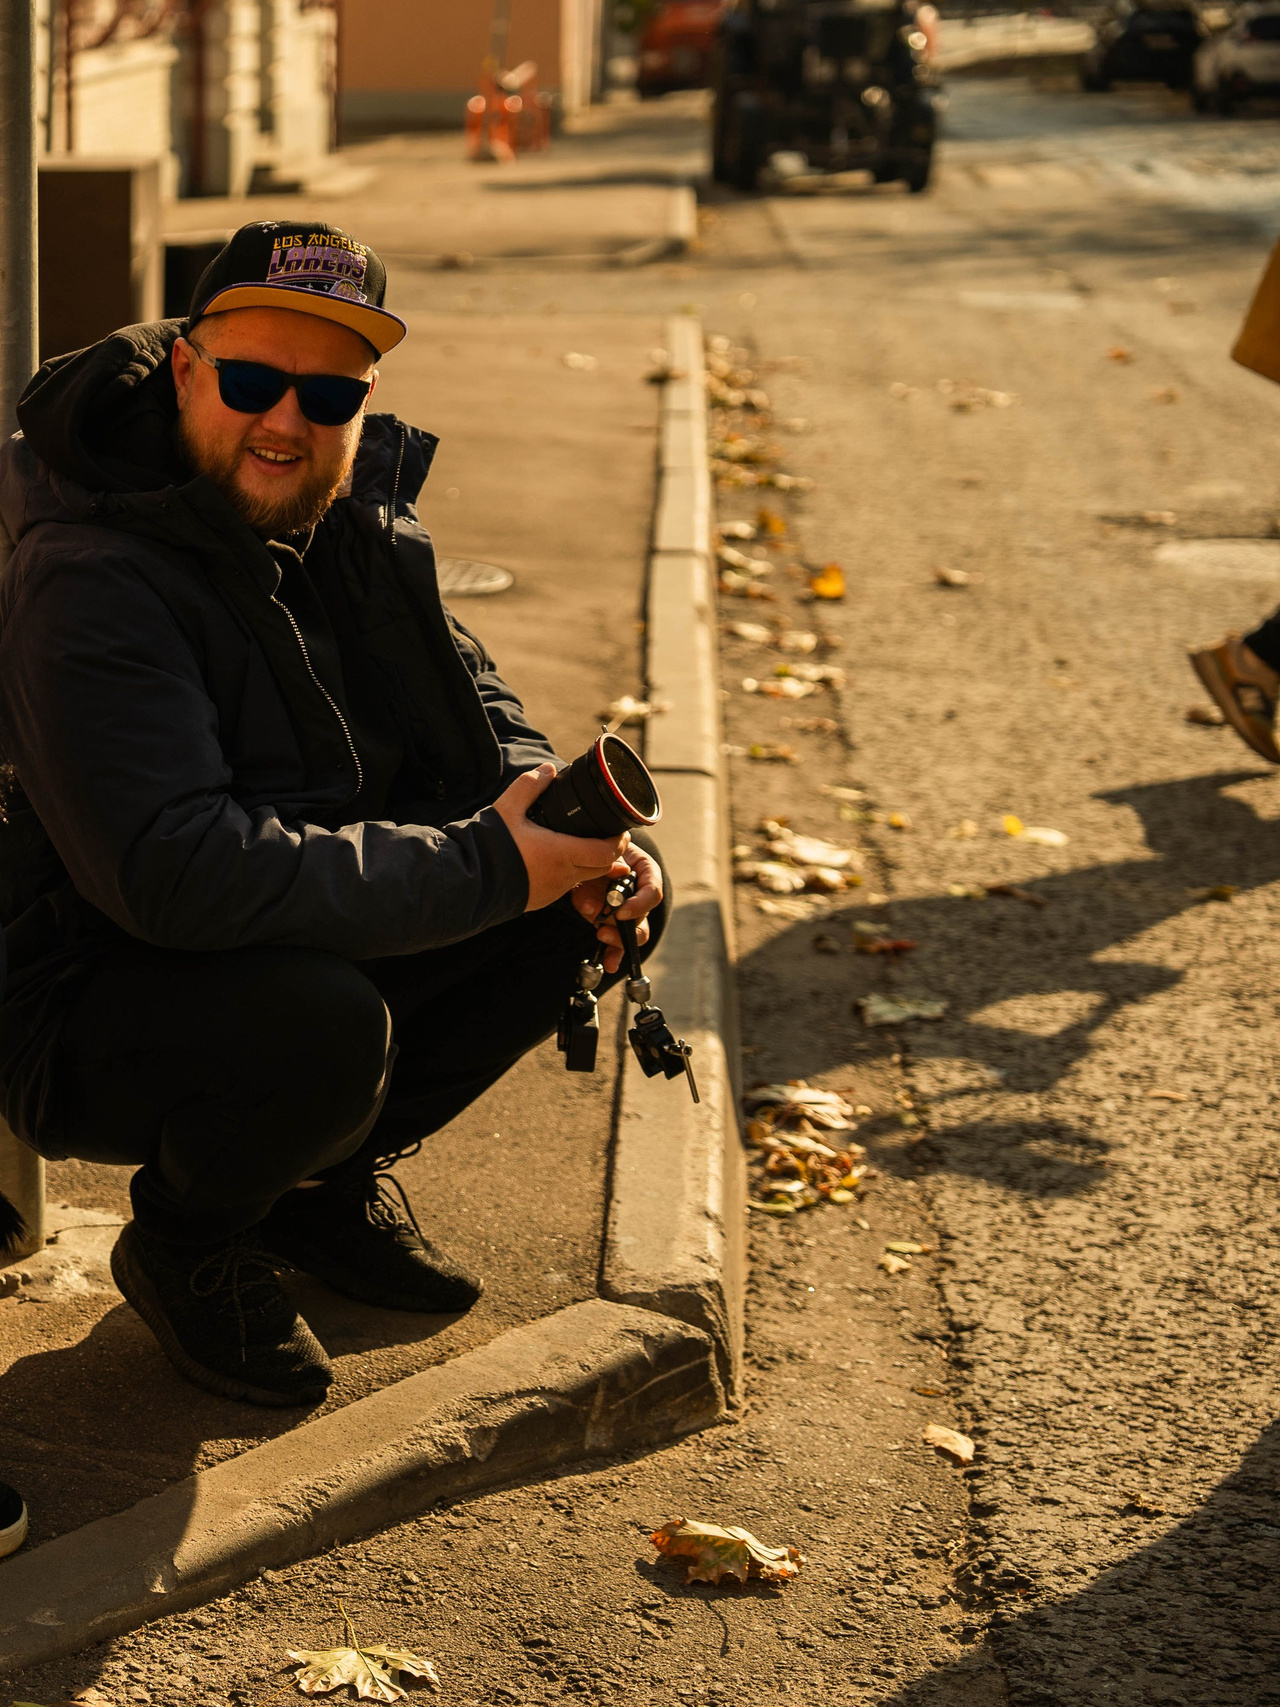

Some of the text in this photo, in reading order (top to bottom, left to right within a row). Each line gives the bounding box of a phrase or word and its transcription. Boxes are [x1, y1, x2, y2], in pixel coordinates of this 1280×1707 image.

[273, 232, 368, 256] LOS ANGELES
[268, 246, 368, 280] LAKERS
[566, 805, 581, 817] SONY
